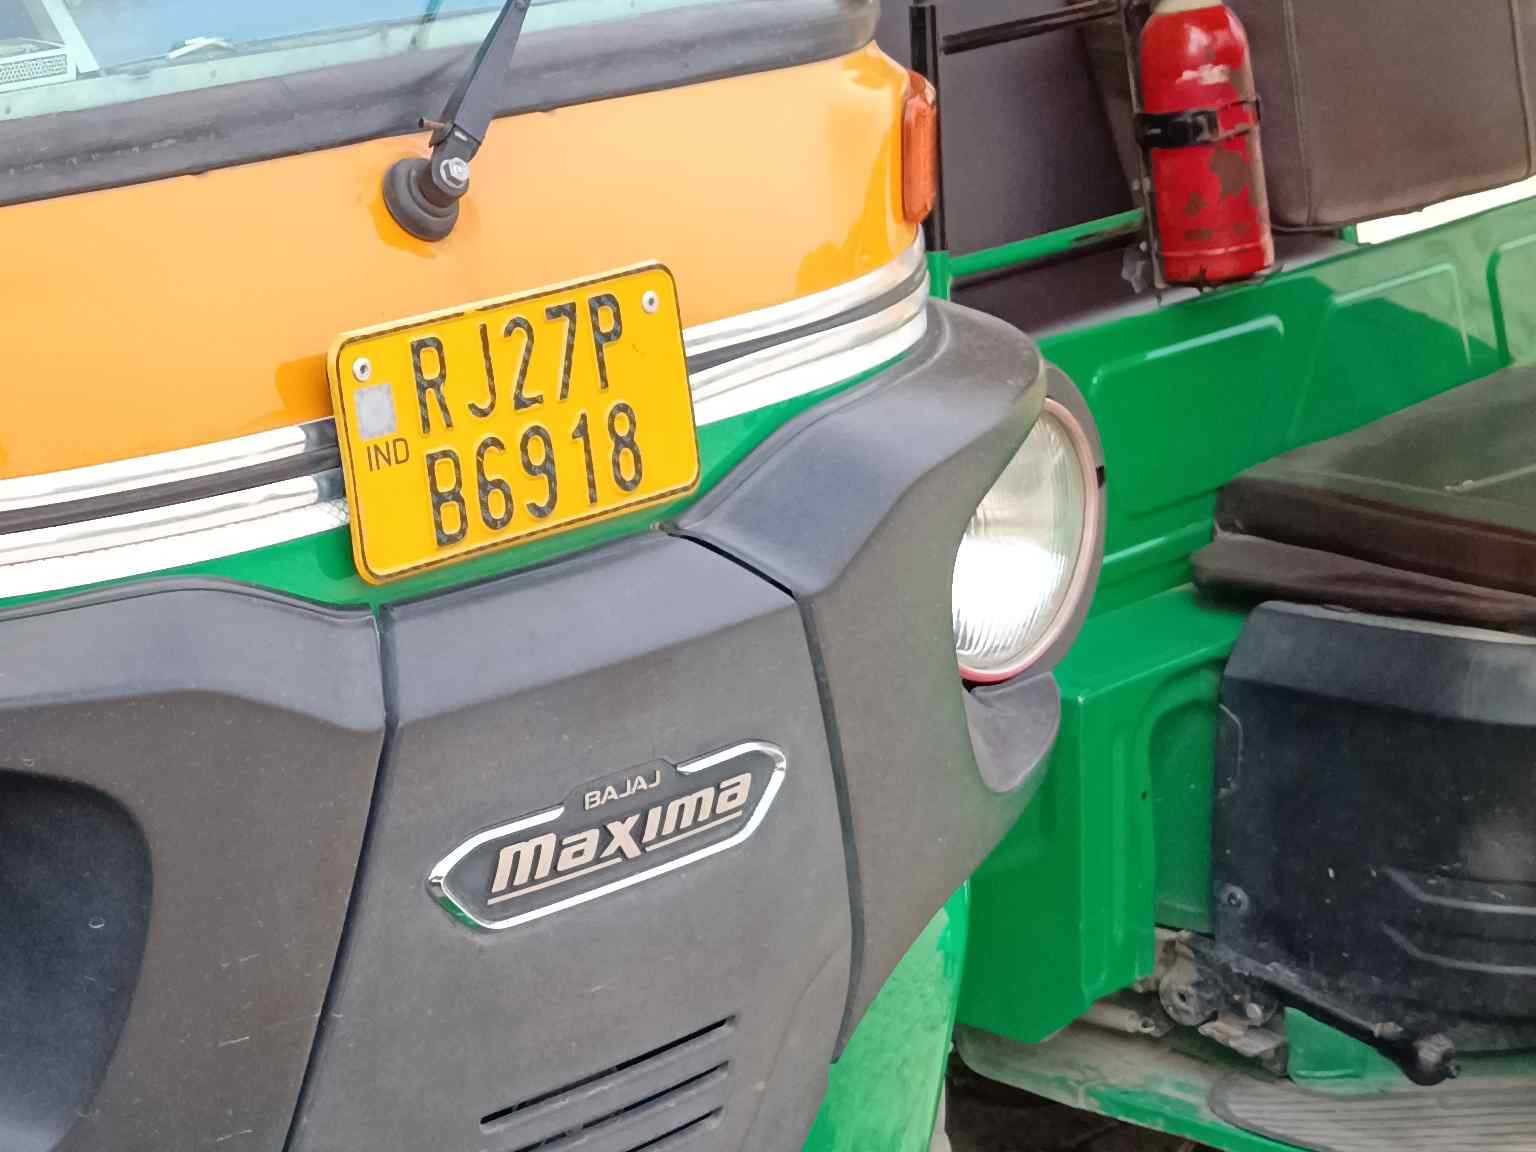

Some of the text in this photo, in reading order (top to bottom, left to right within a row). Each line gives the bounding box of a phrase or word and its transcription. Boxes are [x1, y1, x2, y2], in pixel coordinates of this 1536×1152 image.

[410, 293, 624, 434] RJ27P
[366, 438, 410, 472] IND
[425, 402, 643, 547] B6918
[584, 770, 662, 810] BAJAJ
